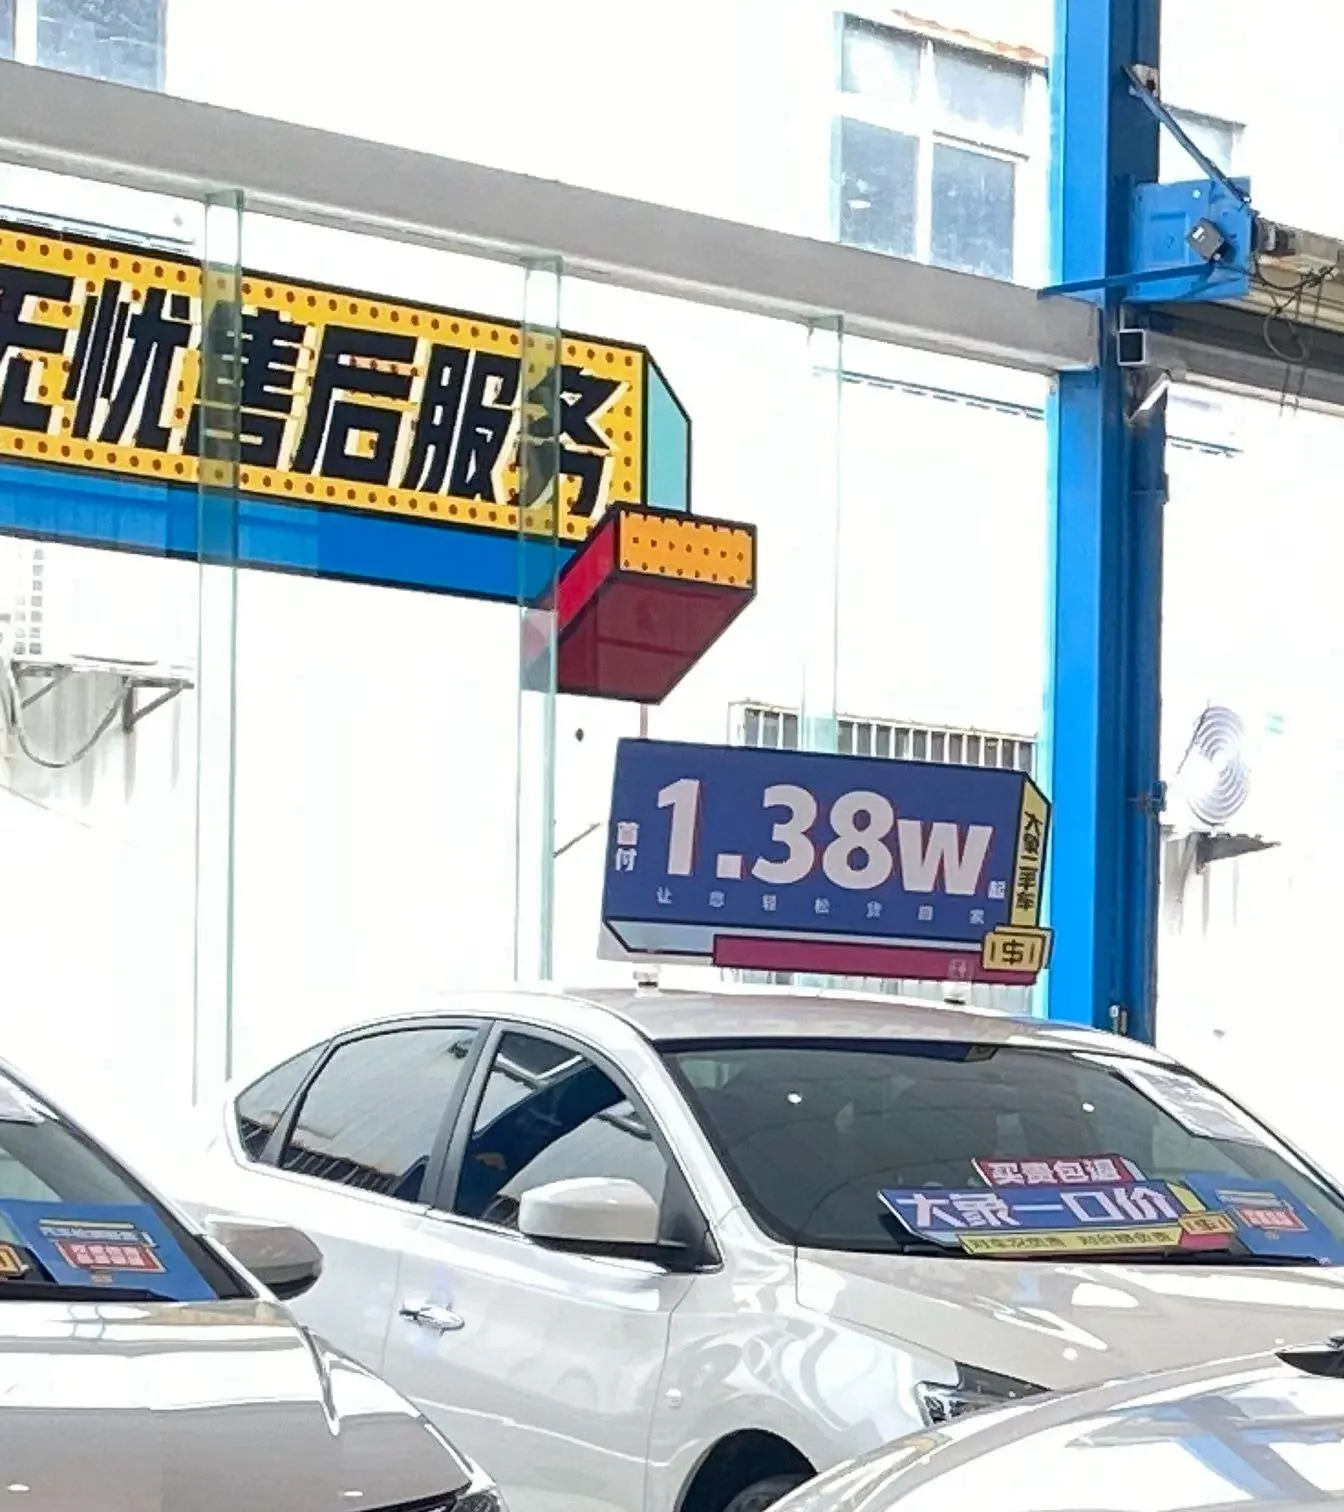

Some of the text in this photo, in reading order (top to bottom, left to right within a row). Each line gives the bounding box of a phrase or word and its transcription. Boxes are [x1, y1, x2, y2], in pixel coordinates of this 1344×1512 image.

[986, 1158, 1122, 1186] 买贵包退
[896, 1186, 1178, 1228] 大象一口价
